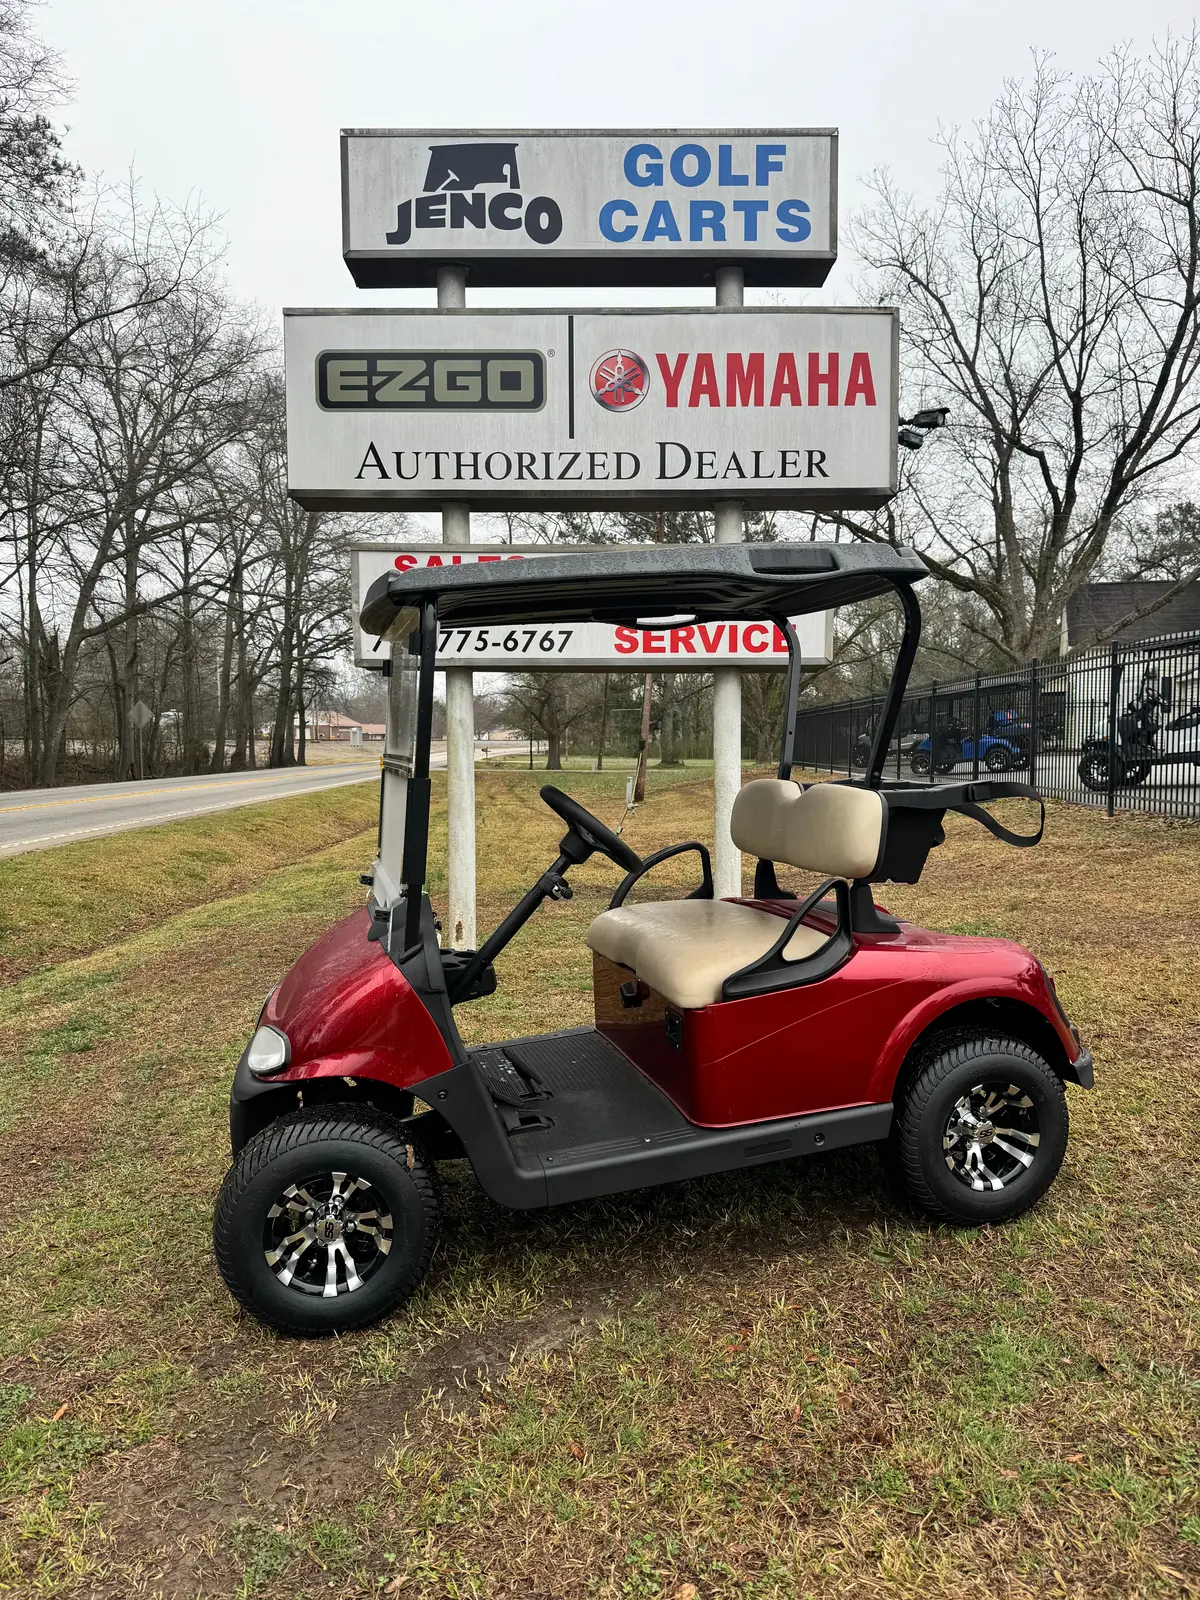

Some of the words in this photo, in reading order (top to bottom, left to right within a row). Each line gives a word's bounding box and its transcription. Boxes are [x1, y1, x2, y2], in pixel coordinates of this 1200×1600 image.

[623, 143, 787, 188] GOLF
[386, 192, 563, 245] JENCO
[598, 198, 813, 243] CARTS
[656, 352, 877, 408] YAMAHA
[355, 441, 641, 481] AUTHORIZED
[655, 441, 830, 480] DEALER
